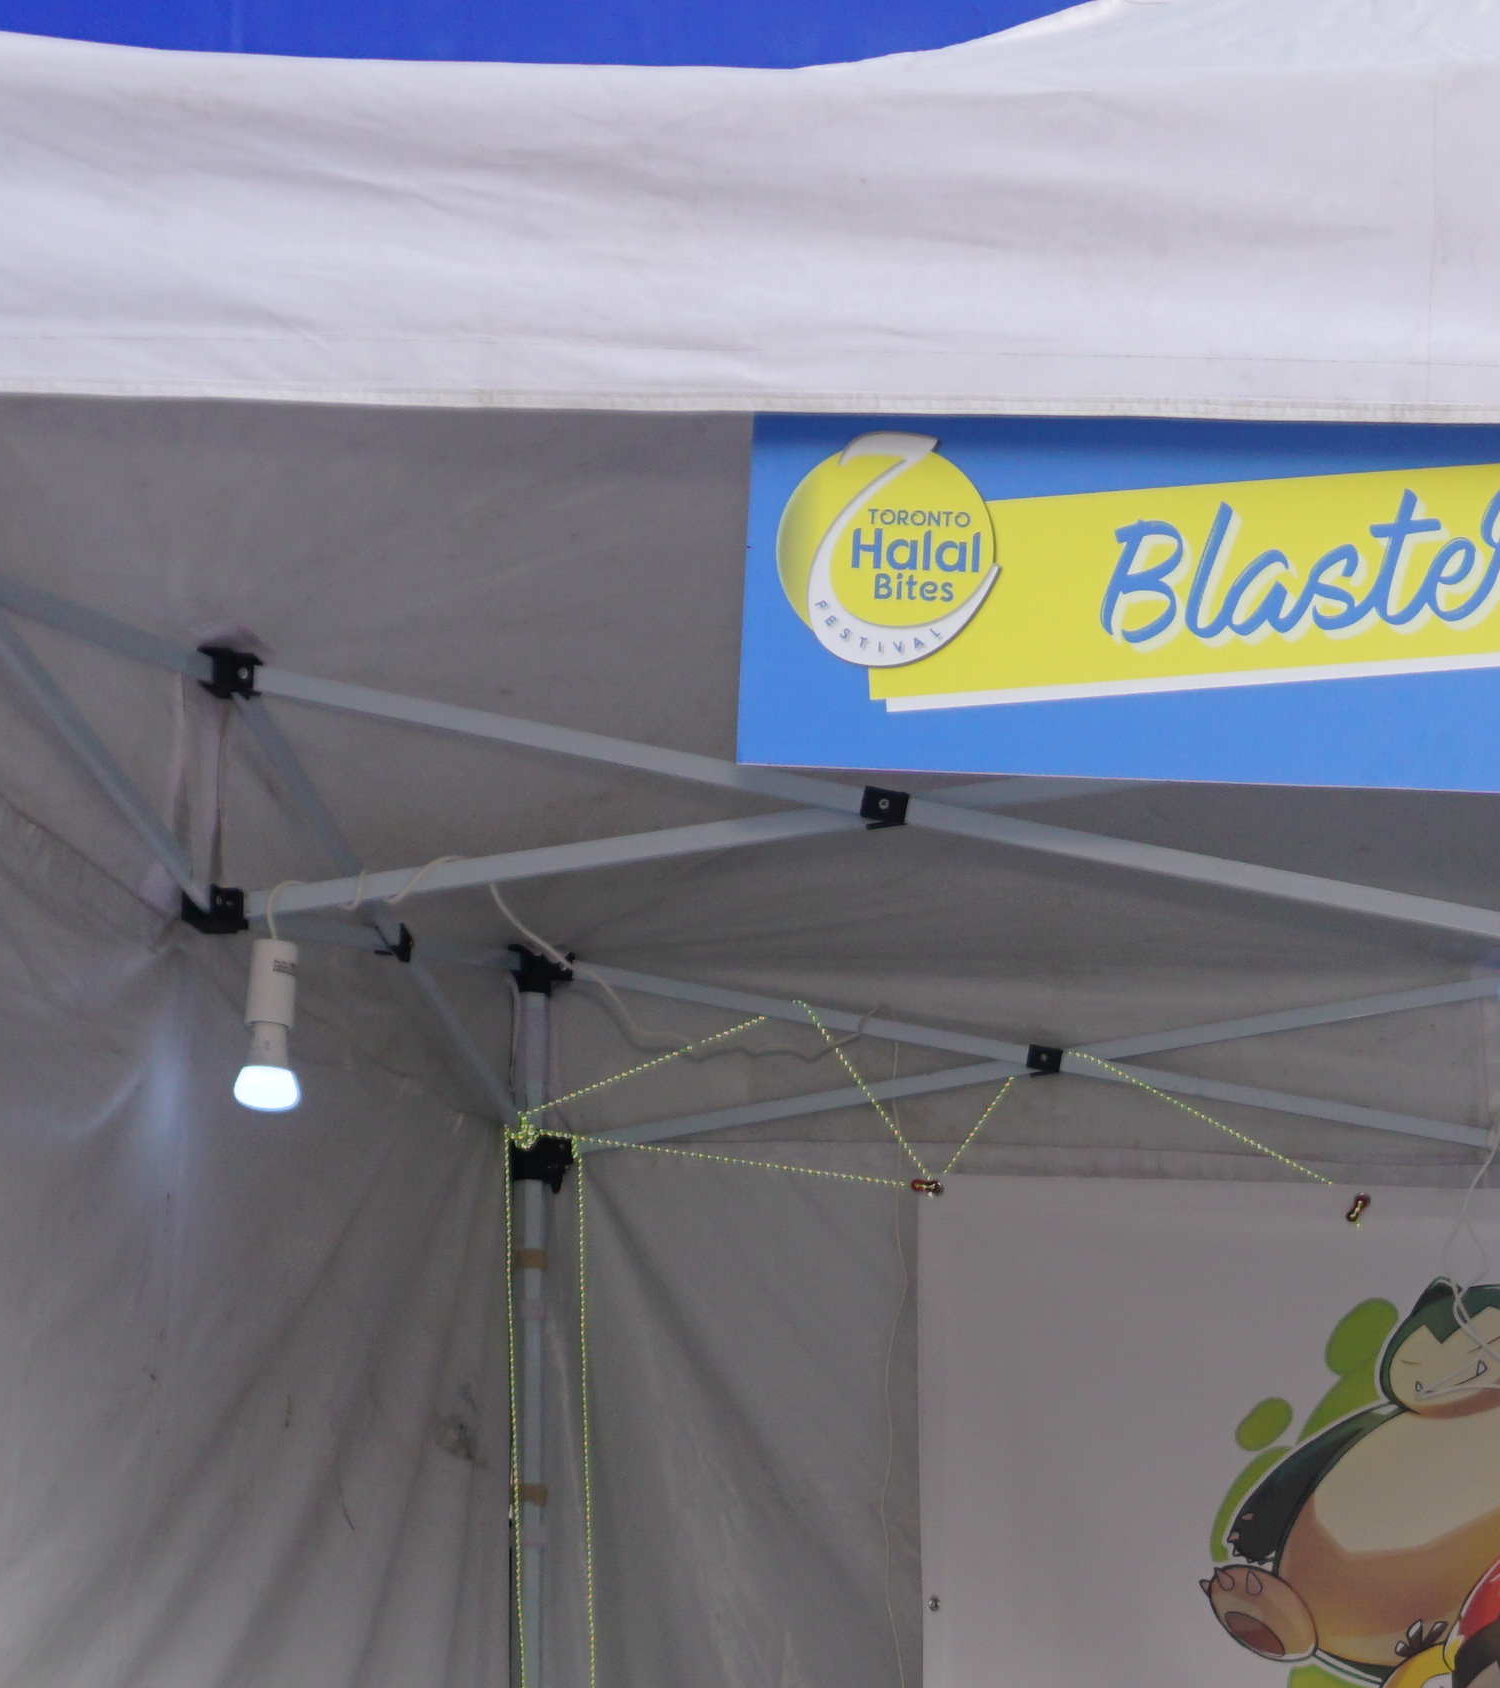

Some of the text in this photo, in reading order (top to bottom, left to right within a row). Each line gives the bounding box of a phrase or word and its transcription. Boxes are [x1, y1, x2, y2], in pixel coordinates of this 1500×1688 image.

[868, 509, 971, 528] TORONTO
[851, 527, 981, 573] Halal
[874, 573, 954, 602] Bites
[815, 599, 942, 653] FESTIVAL
